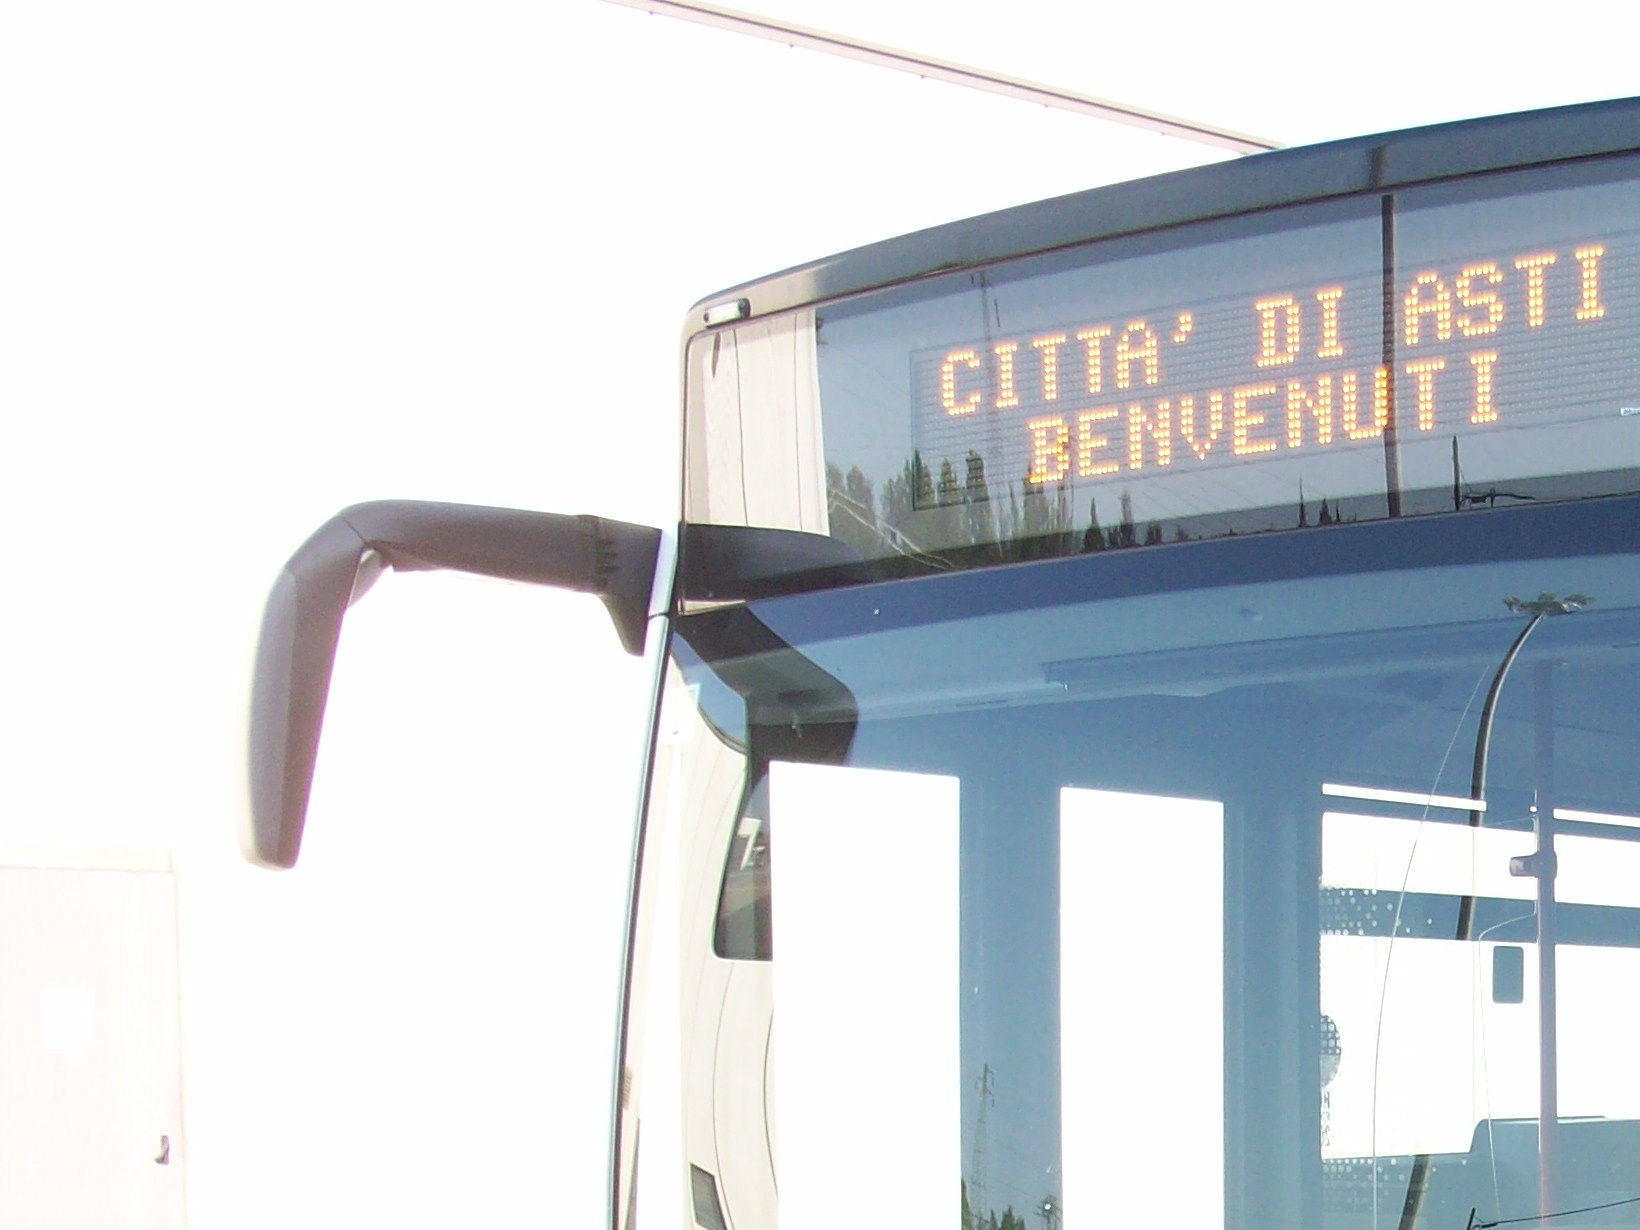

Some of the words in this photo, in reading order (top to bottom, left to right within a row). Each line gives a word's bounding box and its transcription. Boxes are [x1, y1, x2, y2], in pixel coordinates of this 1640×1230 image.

[939, 312, 1193, 417] CITTA'
[1254, 284, 1347, 368] DI
[1402, 243, 1608, 346] ASTI
[1028, 351, 1498, 485] BENVENUTI
